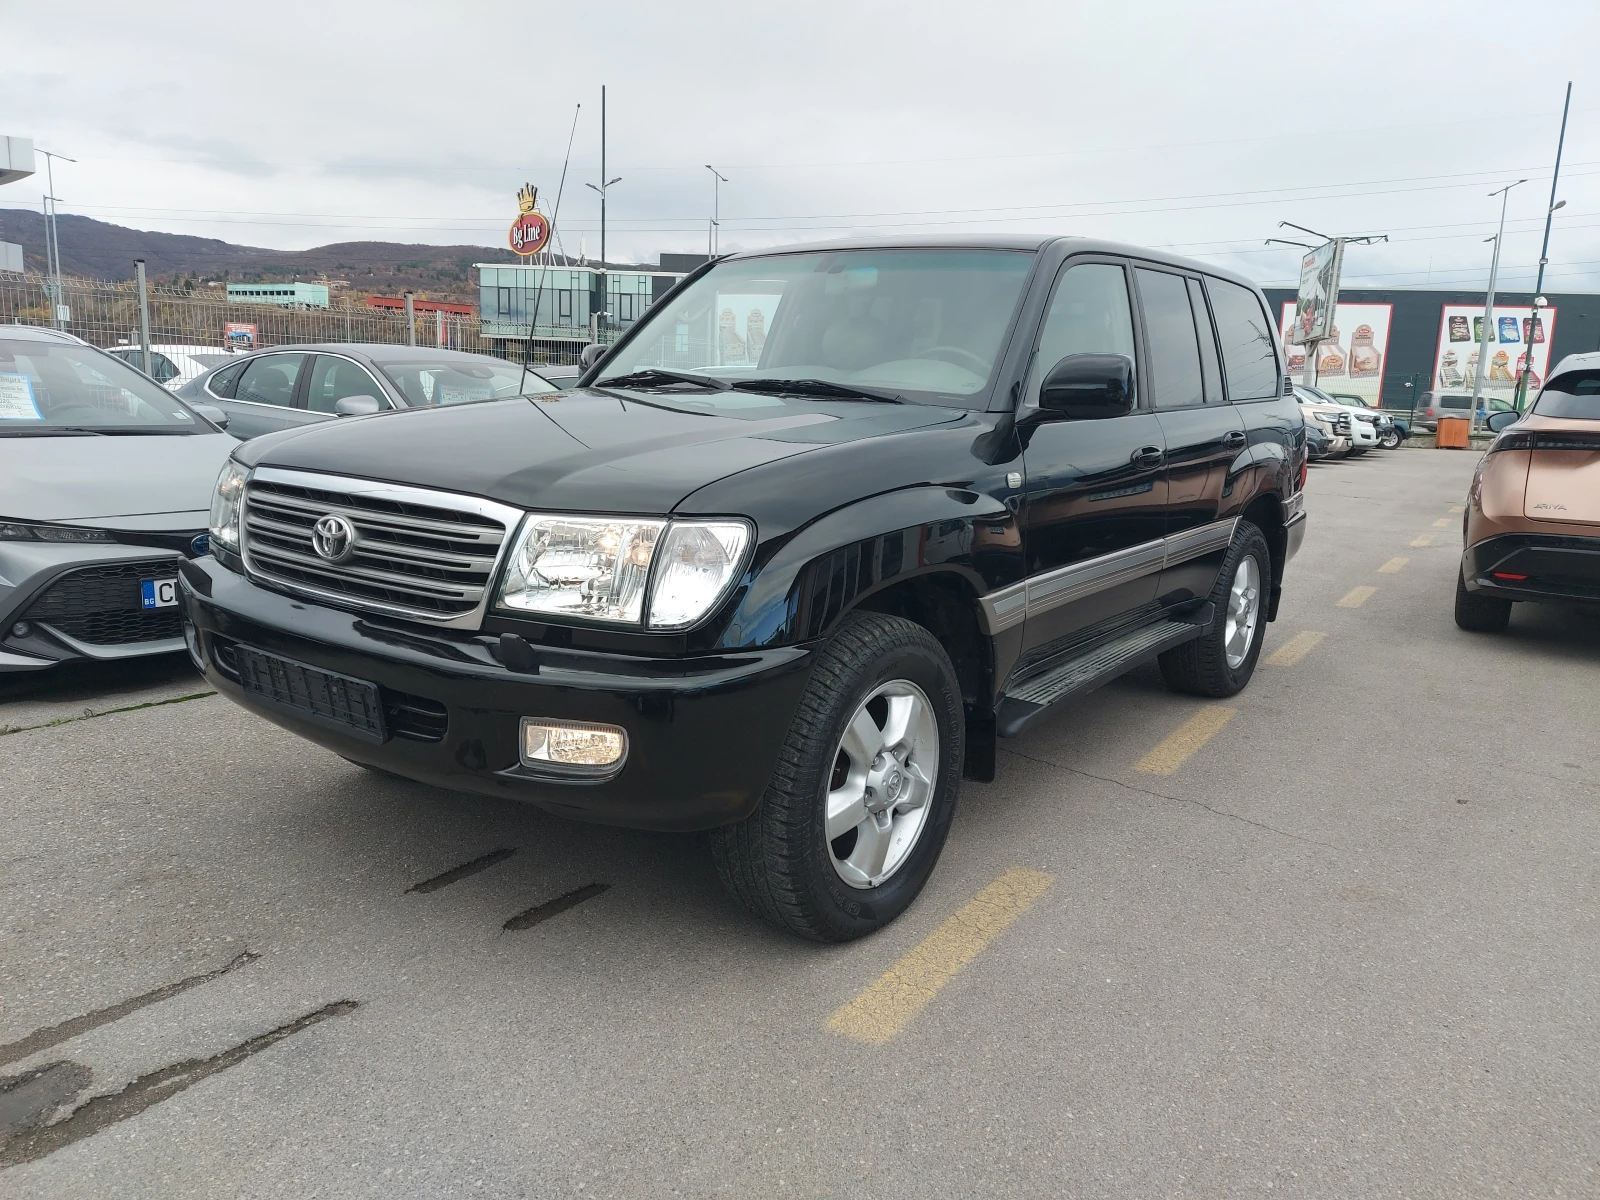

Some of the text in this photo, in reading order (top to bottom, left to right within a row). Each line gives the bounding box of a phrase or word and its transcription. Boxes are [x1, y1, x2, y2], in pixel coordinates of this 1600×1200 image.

[513, 223, 540, 248] Bg Line
[1533, 503, 1567, 511] ARIYA
